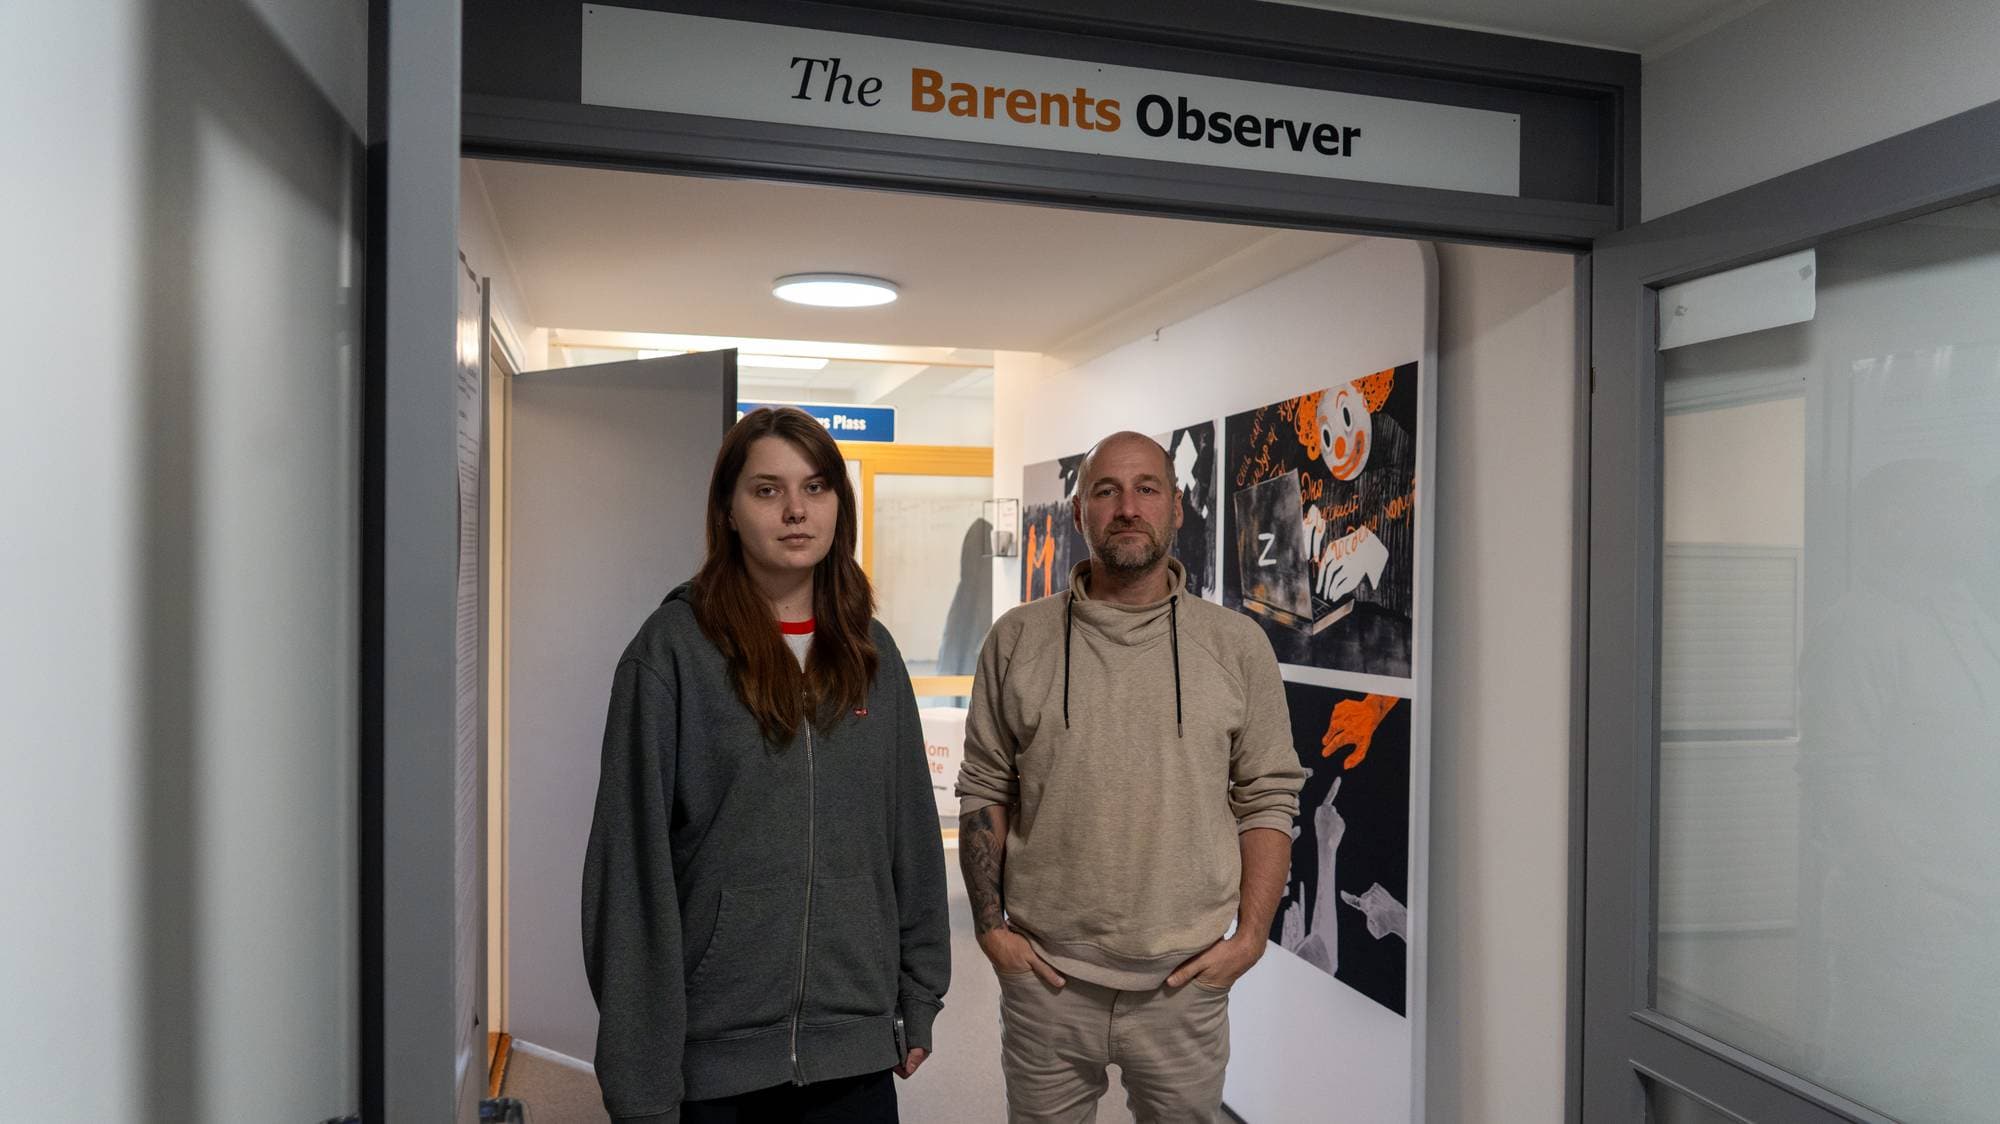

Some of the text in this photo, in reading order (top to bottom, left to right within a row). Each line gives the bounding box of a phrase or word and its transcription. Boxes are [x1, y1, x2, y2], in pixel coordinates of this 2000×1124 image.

[790, 56, 1362, 158] The Barents Observer
[833, 415, 866, 431] Plass
[1257, 532, 1277, 567] Z
